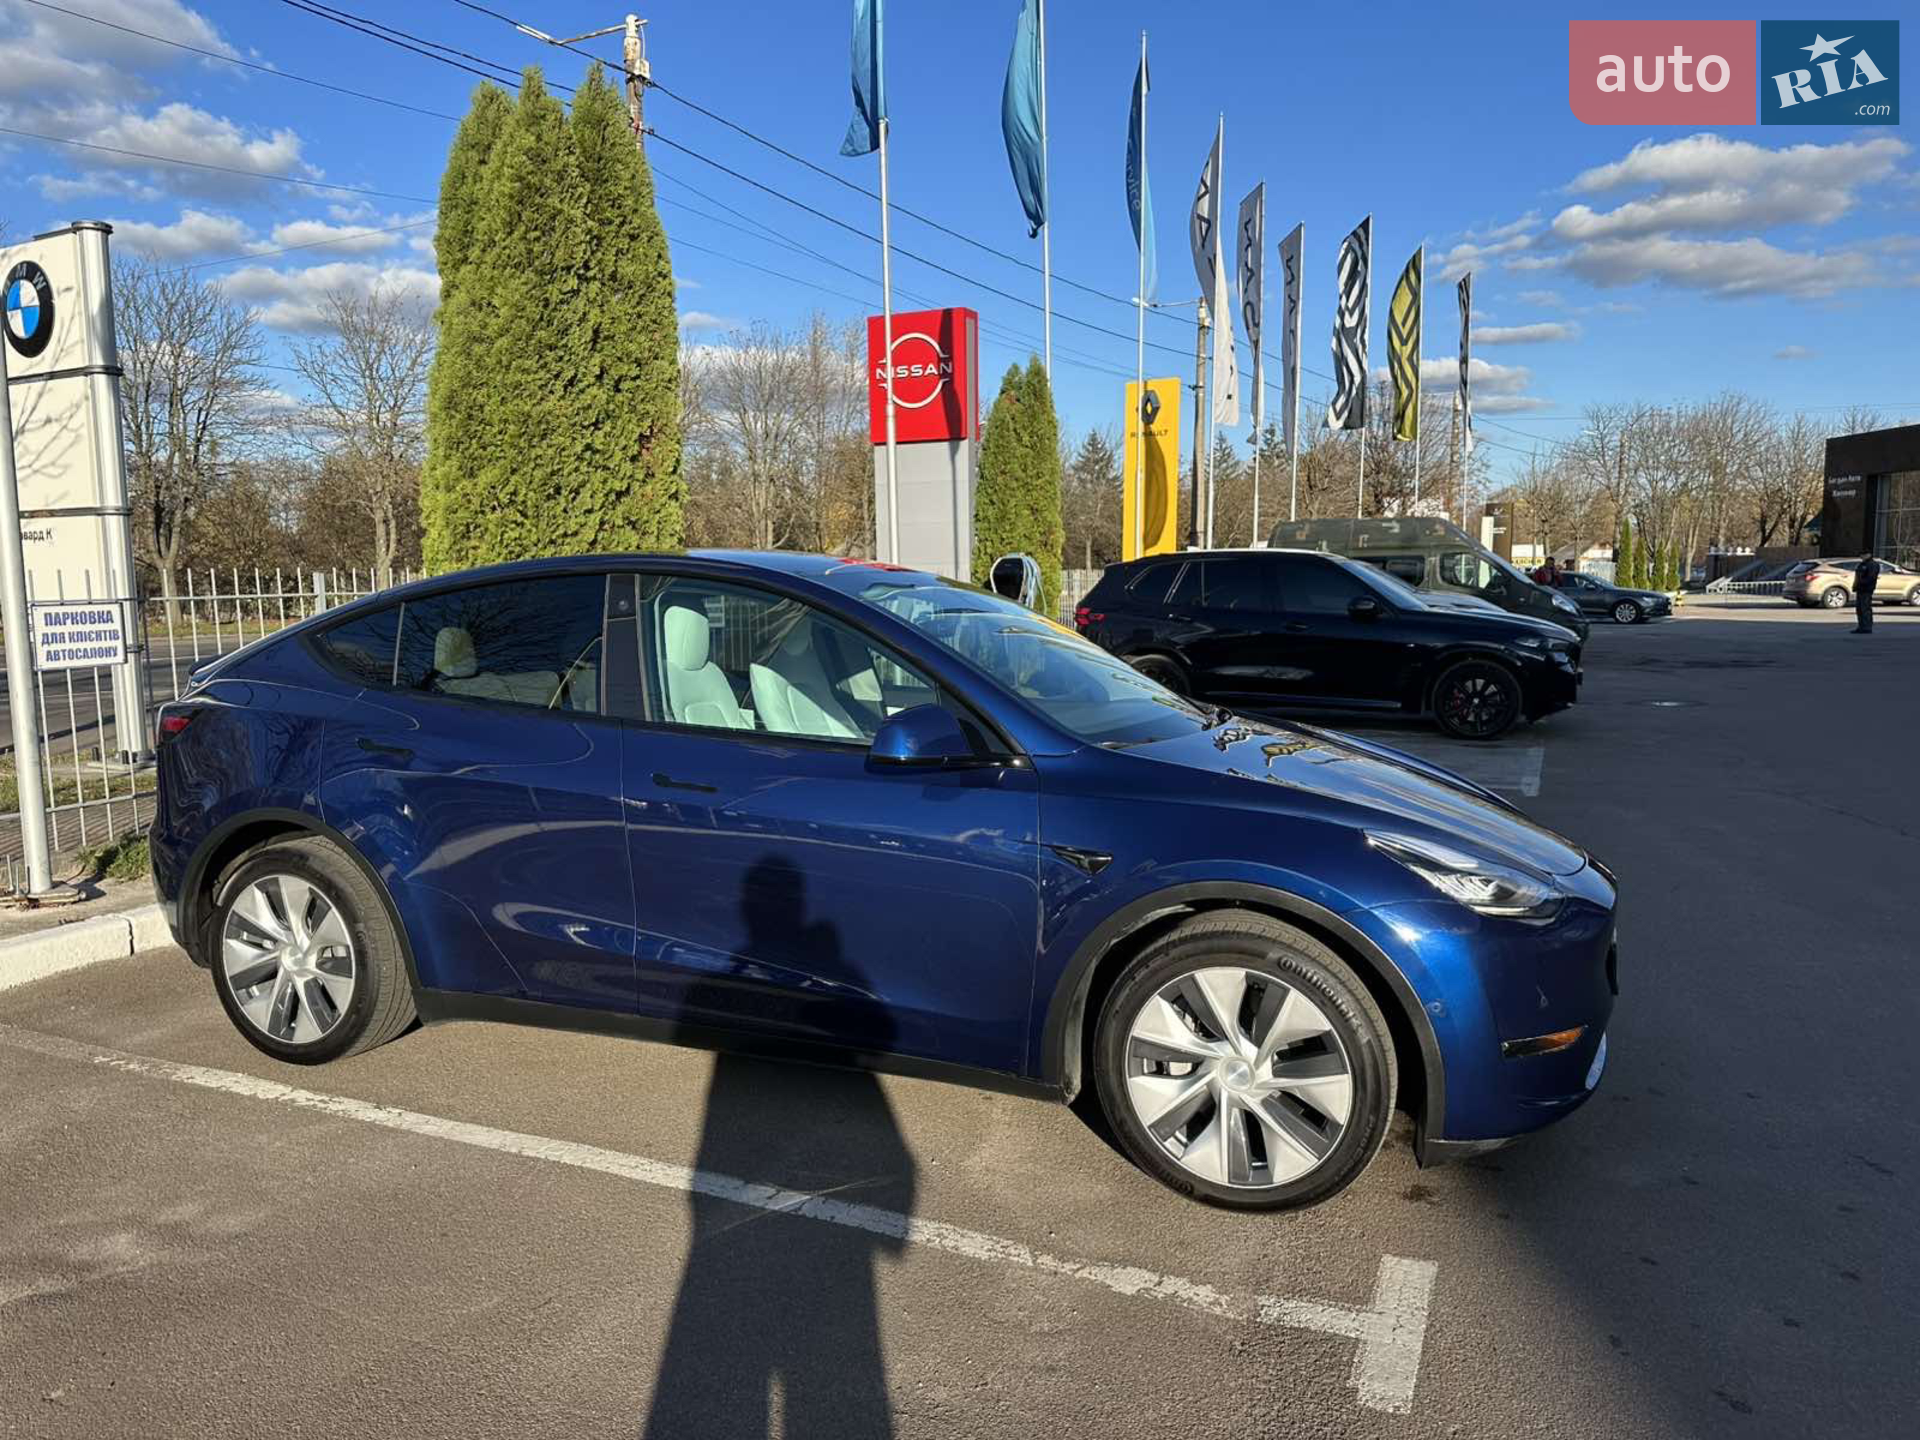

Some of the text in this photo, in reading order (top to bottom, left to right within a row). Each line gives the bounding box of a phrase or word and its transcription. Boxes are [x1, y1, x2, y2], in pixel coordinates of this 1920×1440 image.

[876, 361, 953, 380] NISSAN
[44, 610, 114, 627] ПАРКОВКА
[41, 629, 120, 647] ДЛЯ КЛІЄНТІВ
[46, 646, 118, 662] АВТОСАЛОНУ
